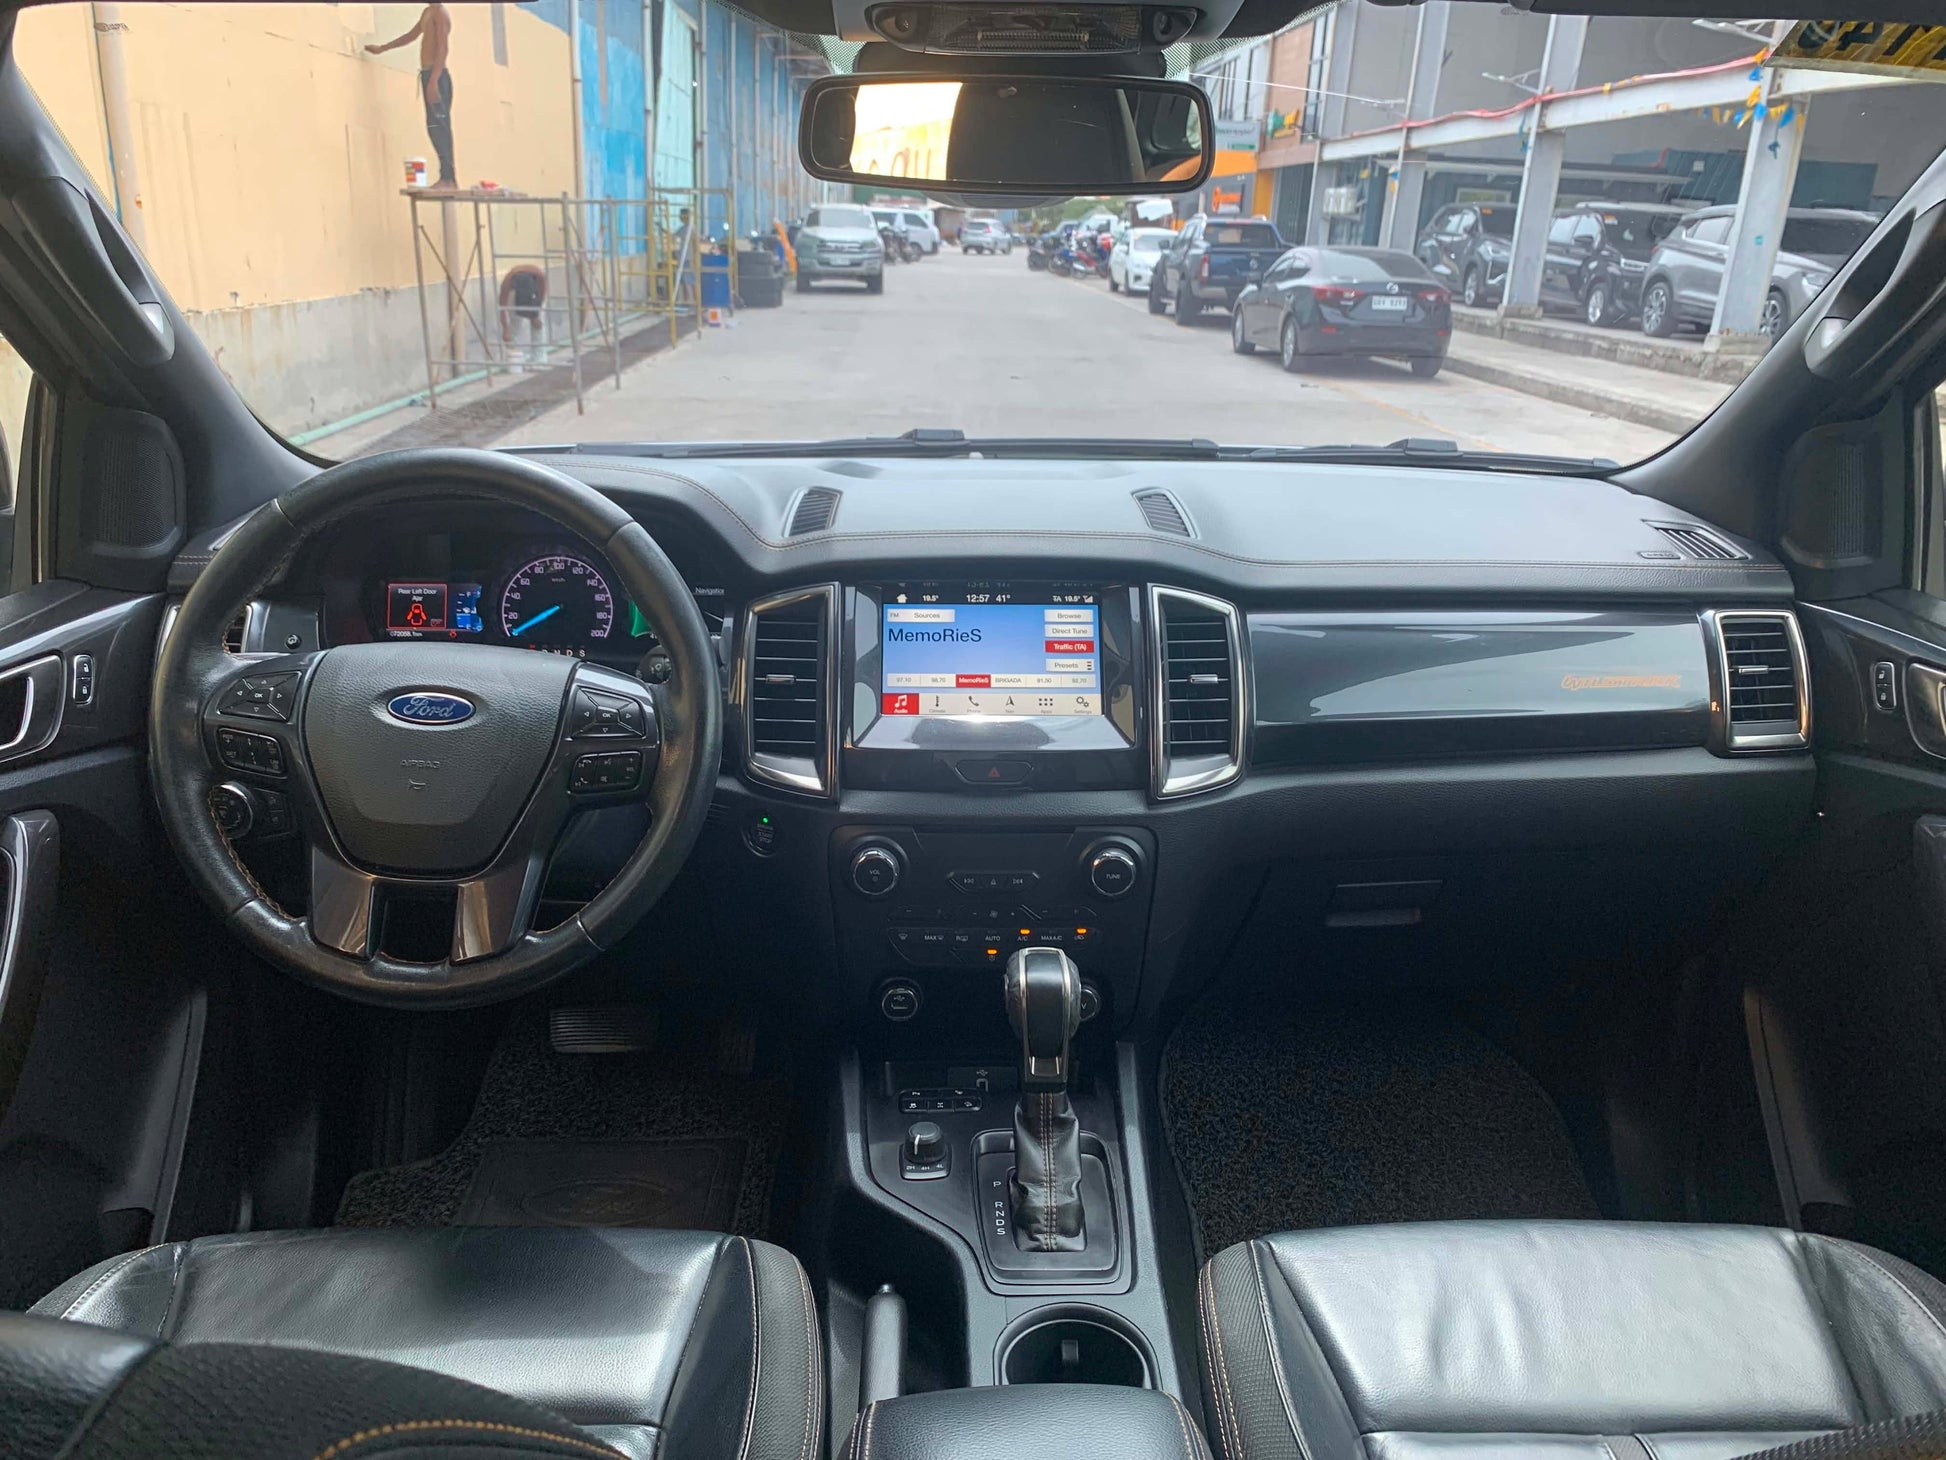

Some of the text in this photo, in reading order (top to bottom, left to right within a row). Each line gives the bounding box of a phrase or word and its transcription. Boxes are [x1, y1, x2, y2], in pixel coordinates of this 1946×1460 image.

[534, 566, 544, 574] 80
[553, 562, 565, 570] 100
[572, 566, 584, 574] 120
[520, 578, 530, 586] 60
[586, 578, 598, 586] 140
[411, 595, 423, 603] Ajar
[511, 592, 521, 600] 40
[594, 593, 606, 602] 160
[922, 594, 939, 602] 19.5°
[966, 593, 1011, 603] 12:57 41°
[508, 612, 518, 620] 20
[596, 611, 608, 619] 180
[913, 611, 941, 619] Sources
[590, 629, 604, 637] 200
[888, 627, 982, 643] MemoRieS
[1051, 627, 1088, 635] Direct Tune
[1053, 643, 1087, 652] Traffic (TA)
[403, 695, 456, 717] Ford
[993, 1180, 1002, 1188] P
[994, 1200, 1004, 1208] R
[996, 1227, 1006, 1235] S
